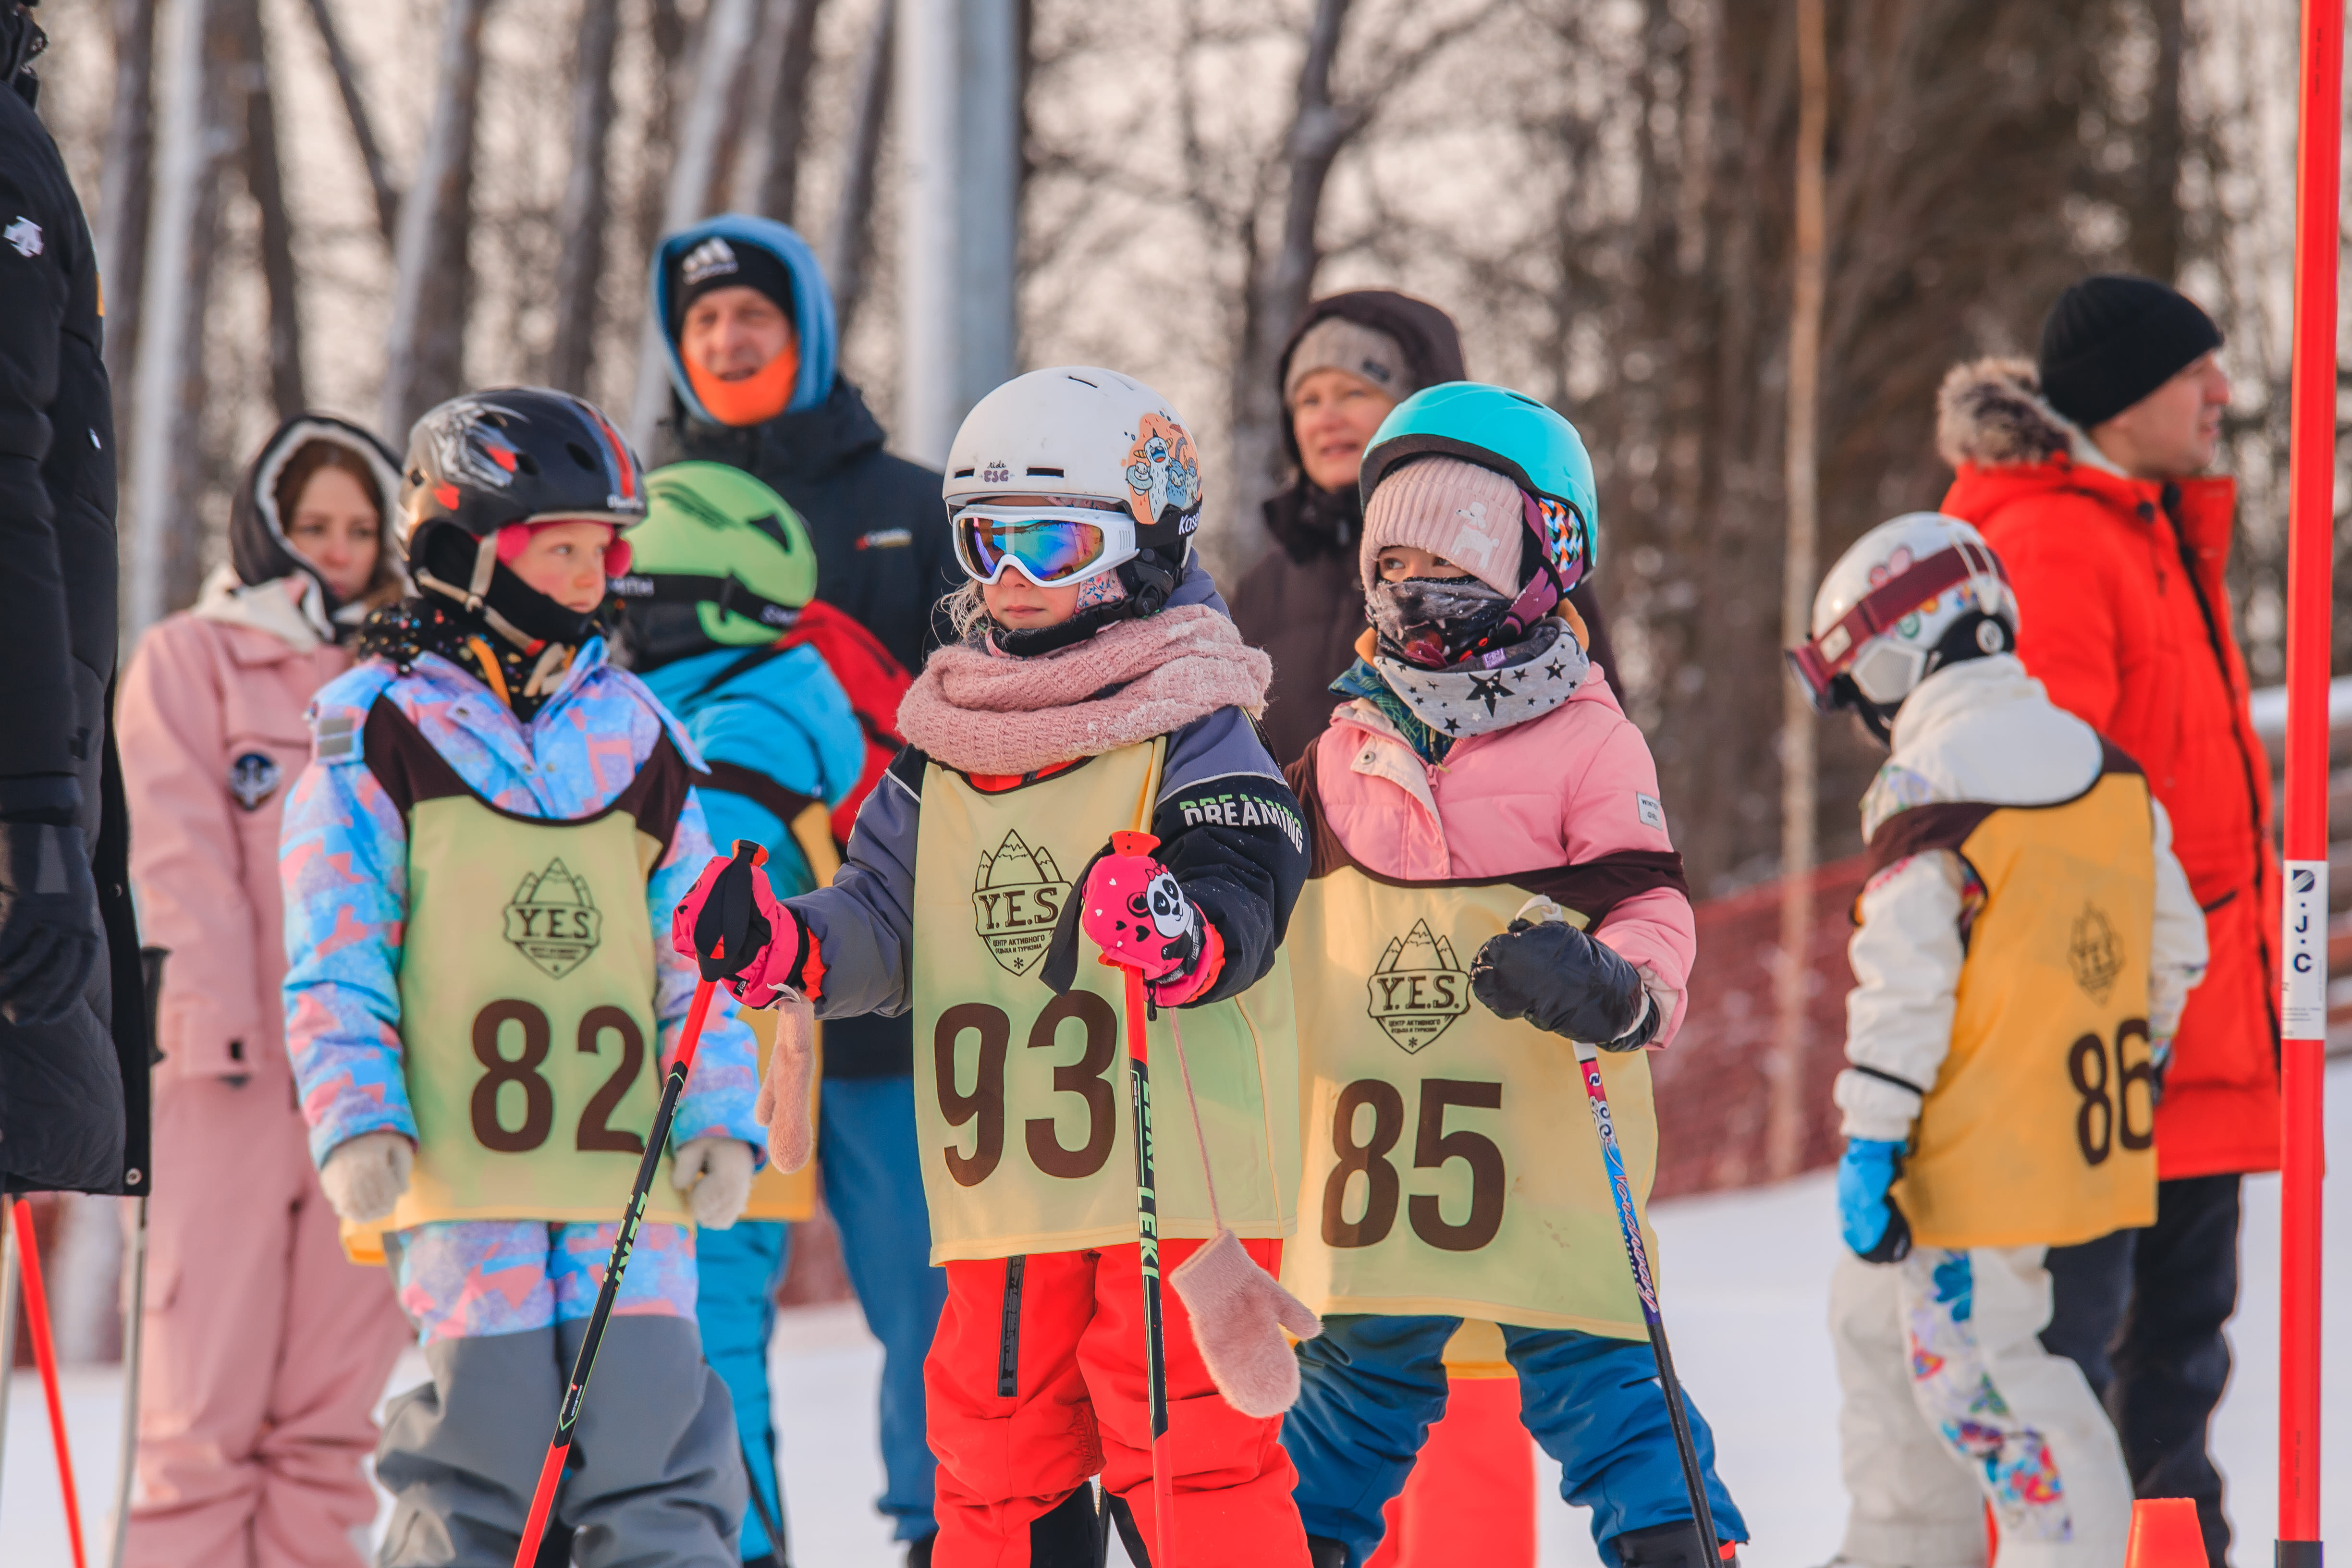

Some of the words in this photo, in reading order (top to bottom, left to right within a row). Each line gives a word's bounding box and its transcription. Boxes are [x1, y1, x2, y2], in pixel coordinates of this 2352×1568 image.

[1183, 800, 1303, 855] DREAMING
[992, 939, 1007, 947] ЦЕНТР
[1008, 934, 1045, 945] АКТИВНОГО
[1017, 943, 1042, 952] ТУРИЗМА
[1377, 975, 1460, 1011] Y.E.S.
[470, 998, 646, 1154] 82
[933, 990, 1118, 1187] 93
[2067, 1017, 2155, 1169] 86
[1321, 1078, 1506, 1252] 85
[1137, 1186, 1159, 1280] LEKI
